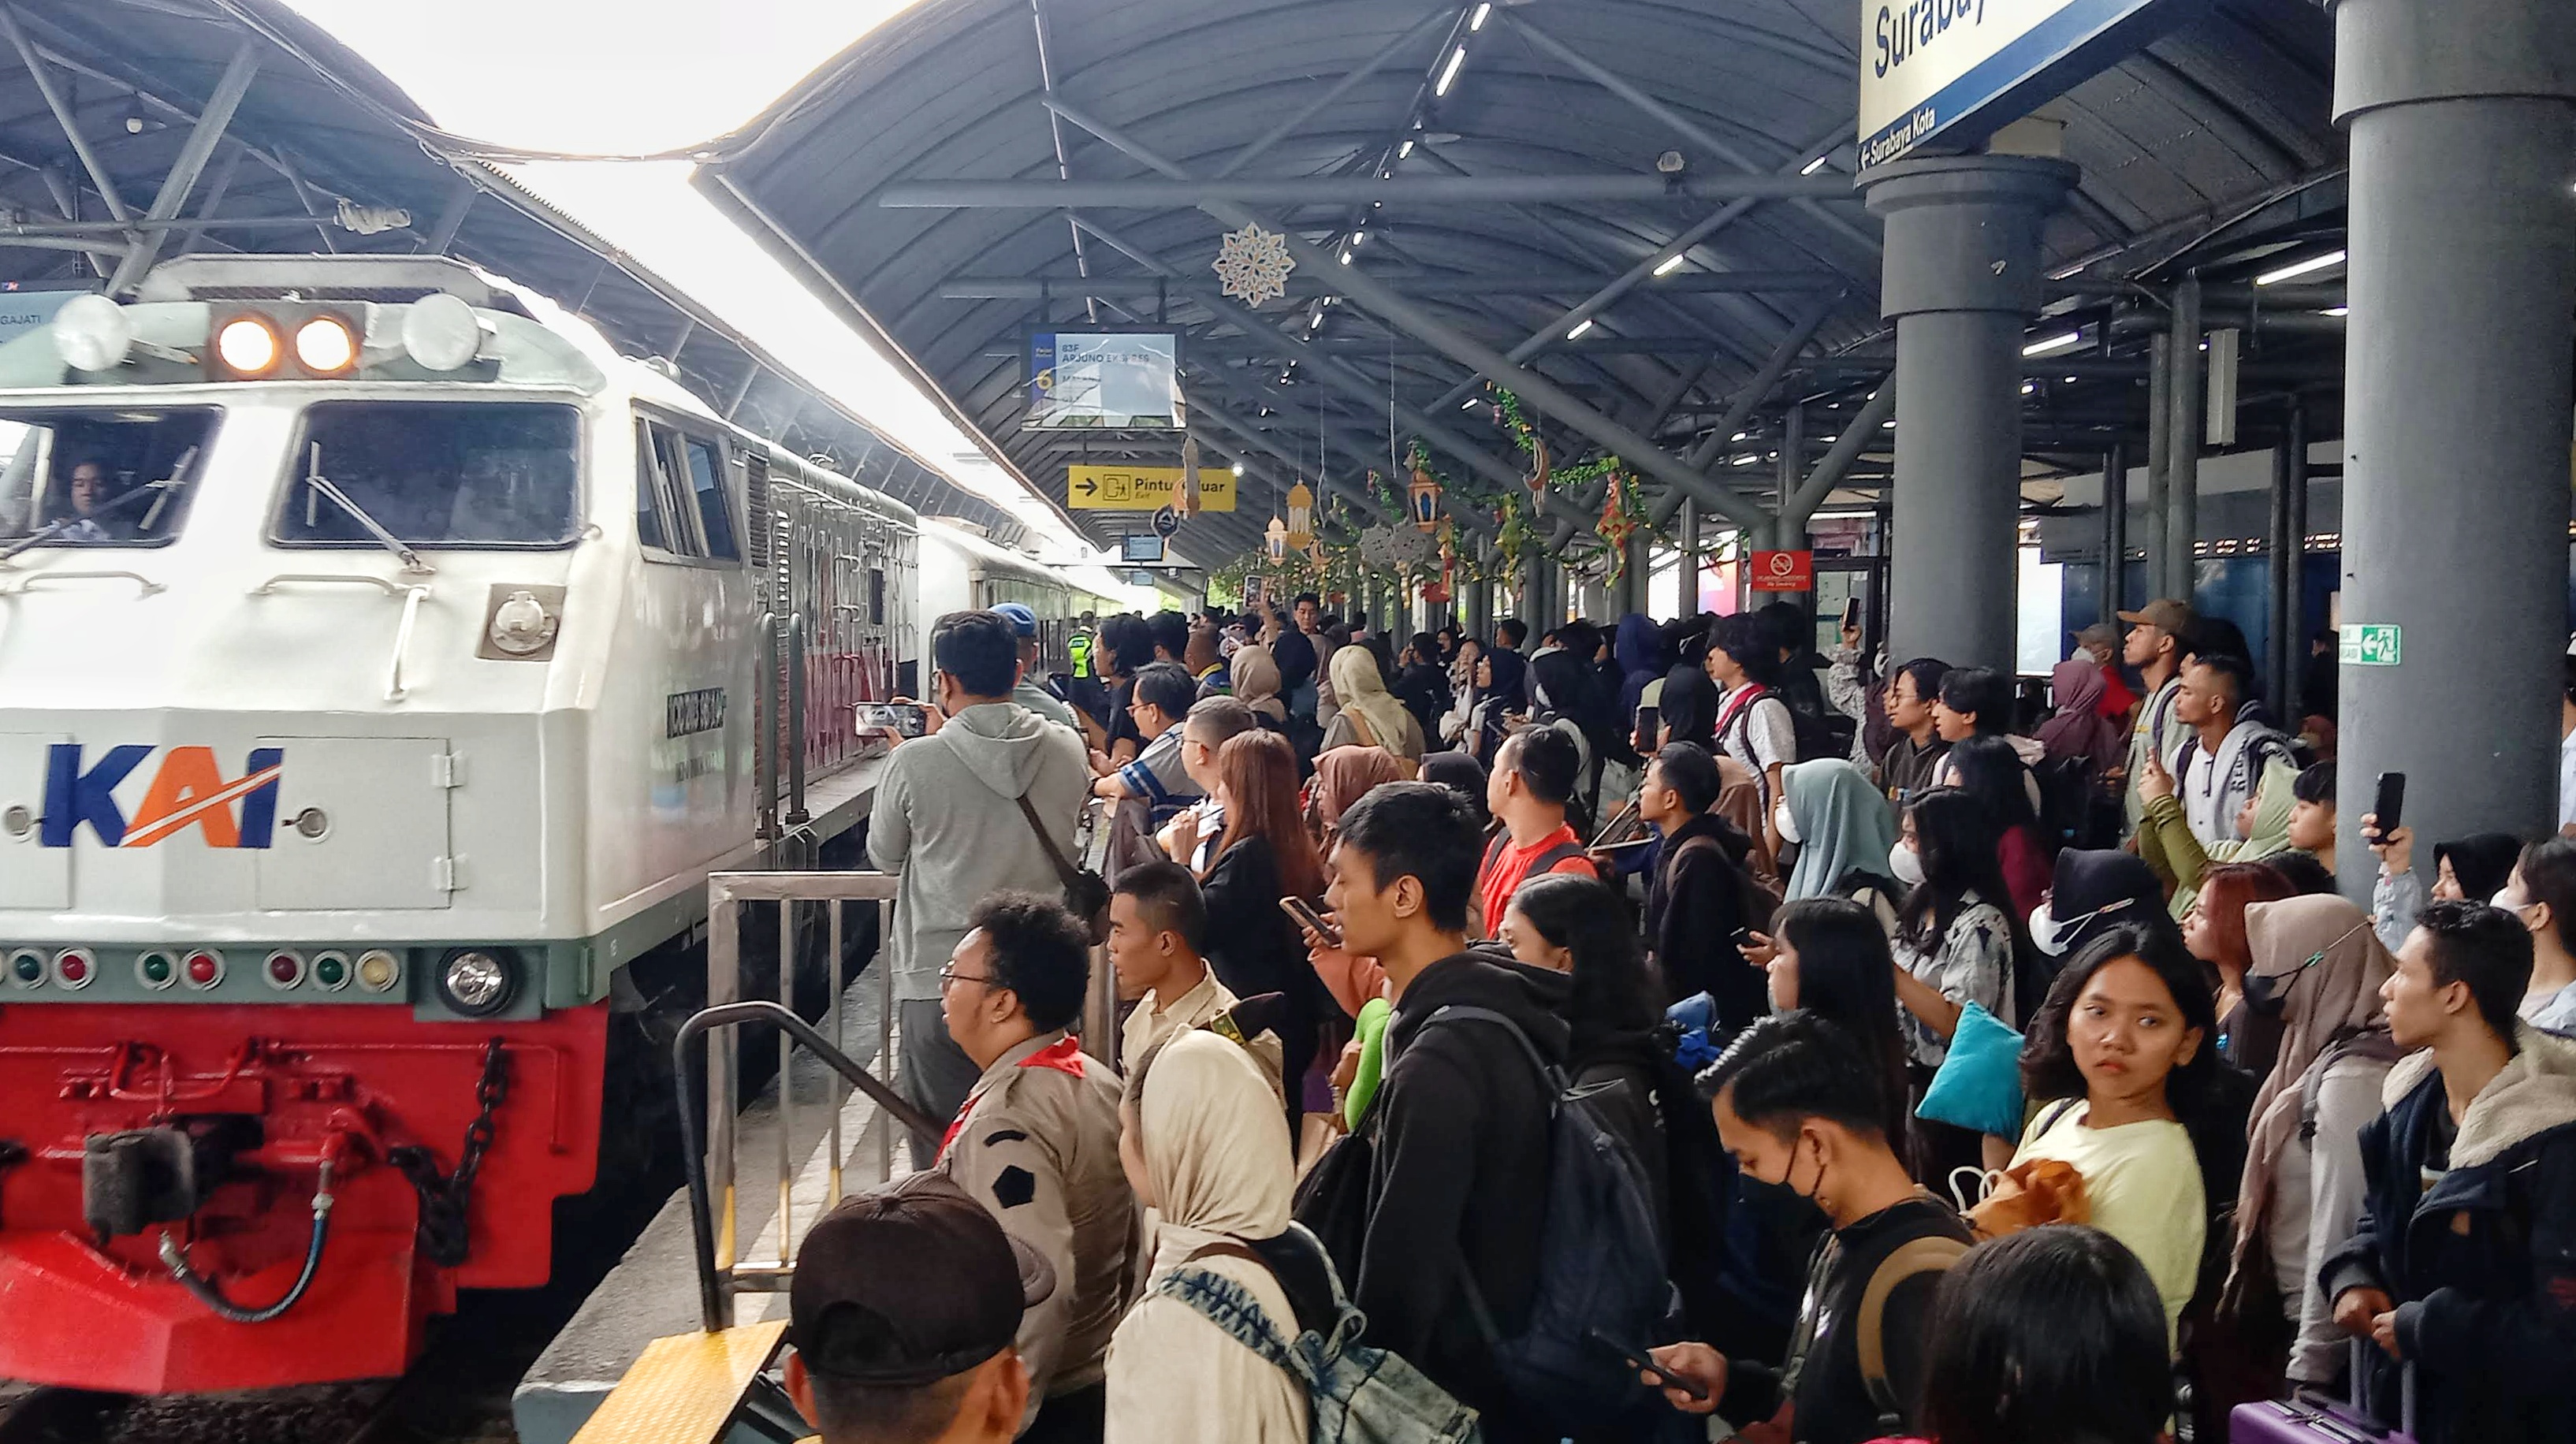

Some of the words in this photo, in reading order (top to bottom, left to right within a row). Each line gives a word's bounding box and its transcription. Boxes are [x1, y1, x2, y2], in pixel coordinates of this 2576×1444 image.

[1870, 124, 1912, 165] Surabaya
[1912, 107, 1936, 140] Kota
[1135, 478, 1173, 491] Pintu
[40, 744, 285, 848] KAI
